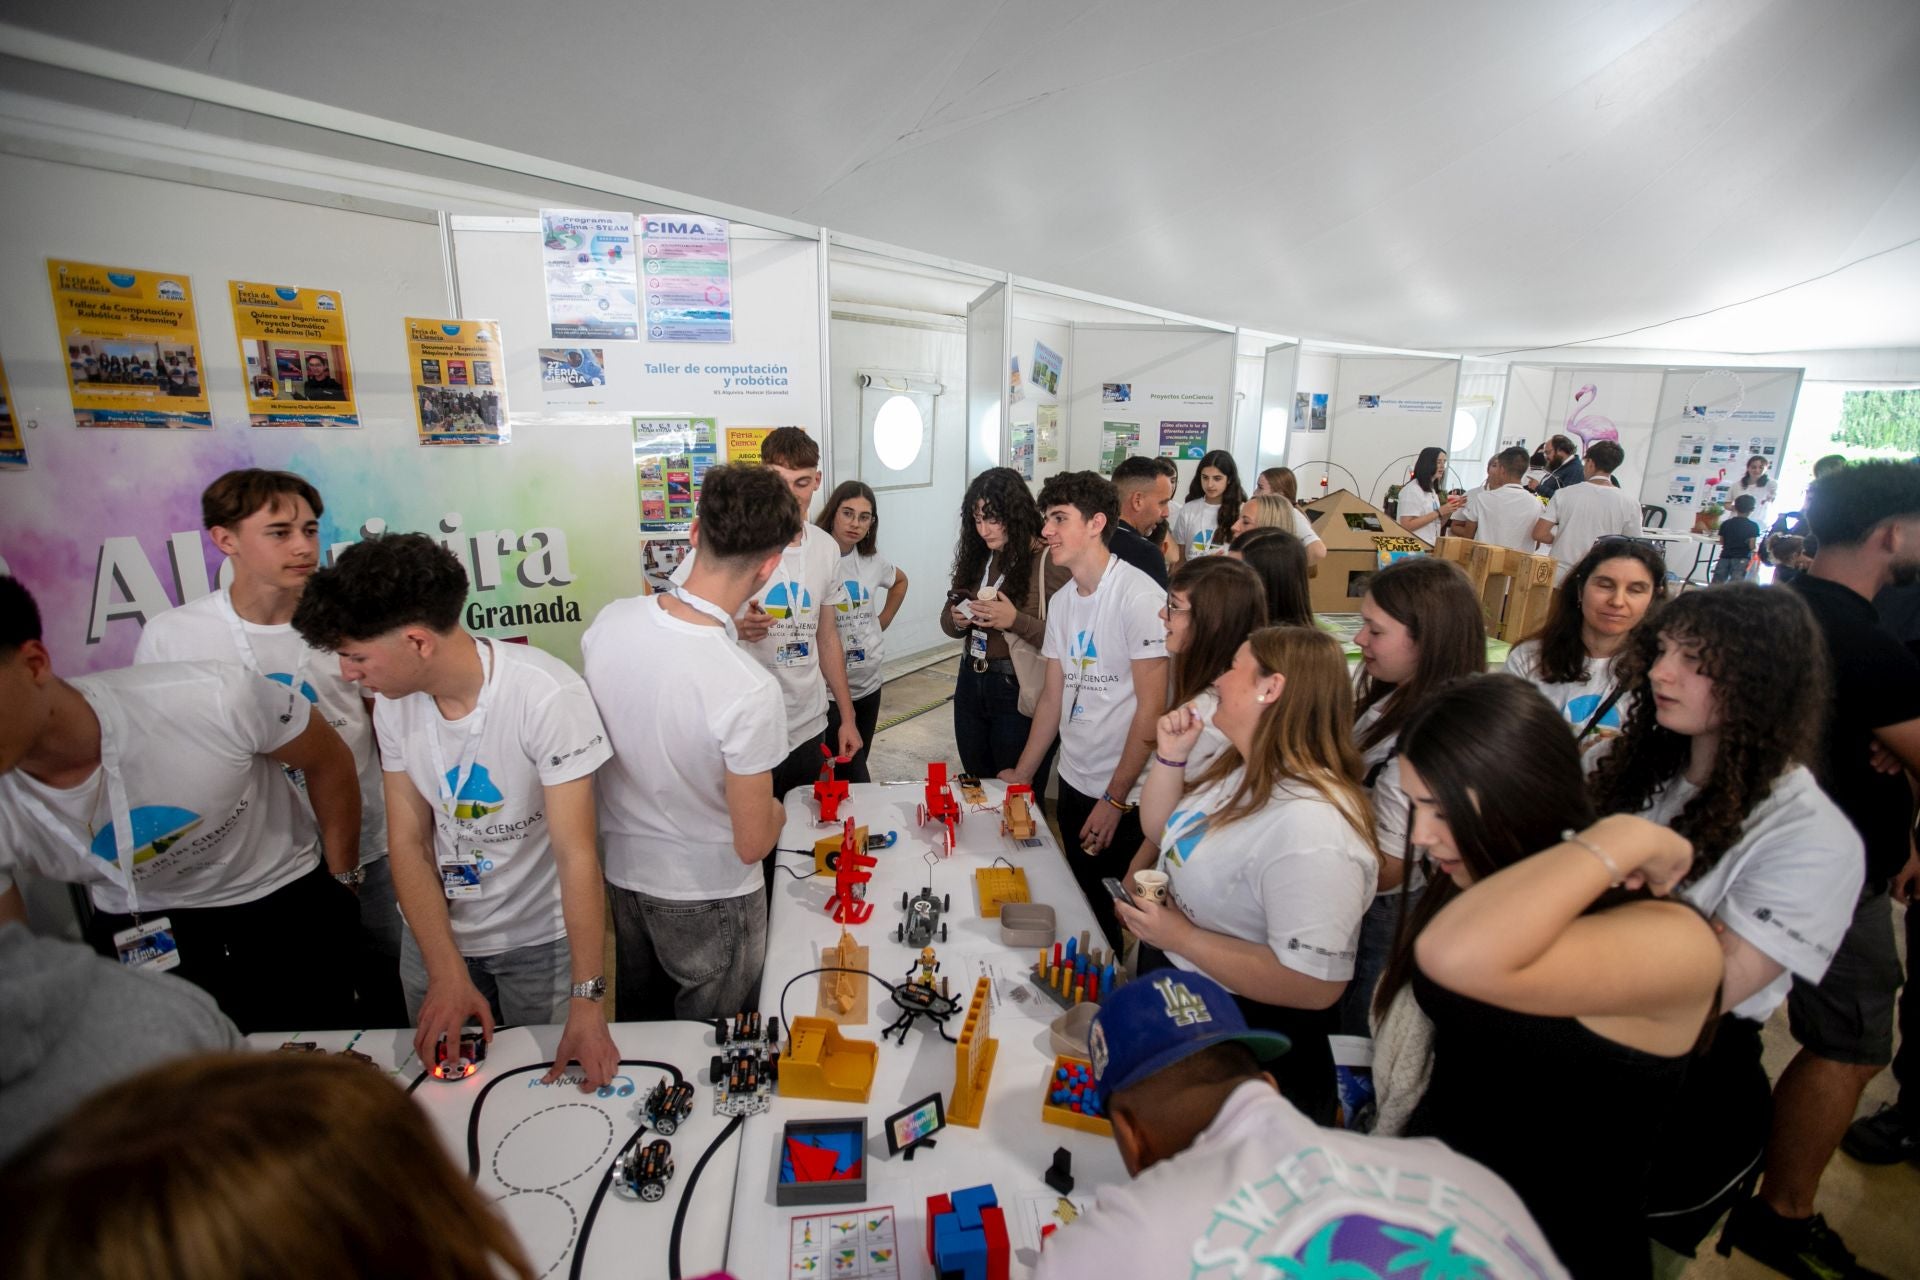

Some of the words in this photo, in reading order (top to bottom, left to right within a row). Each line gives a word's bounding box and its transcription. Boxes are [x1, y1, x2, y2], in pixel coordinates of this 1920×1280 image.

[646, 221, 705, 235] CIMA
[68, 299, 97, 310] Taller
[100, 303, 112, 311] de
[114, 304, 176, 318] Computación
[177, 311, 184, 319] y
[250, 311, 278, 319] Quiero
[130, 314, 178, 326] Streaming
[256, 319, 290, 329] Proyecto
[548, 368, 578, 376] FERIA
[644, 363, 680, 374] Taller
[684, 363, 700, 374] de
[704, 363, 788, 376] computación
[544, 376, 587, 384] CIENCIA
[724, 377, 731, 388] y
[735, 376, 789, 386] robótica
[731, 431, 753, 439] Feria
[1378, 543, 1421, 551] PLANTAS
[466, 595, 583, 630] Granada
[1083, 674, 1119, 683] CIENCIAS
[191, 800, 248, 848] CIENCIAS
[485, 810, 543, 836] CIENCIAS
[1152, 976, 1212, 1027] LA
